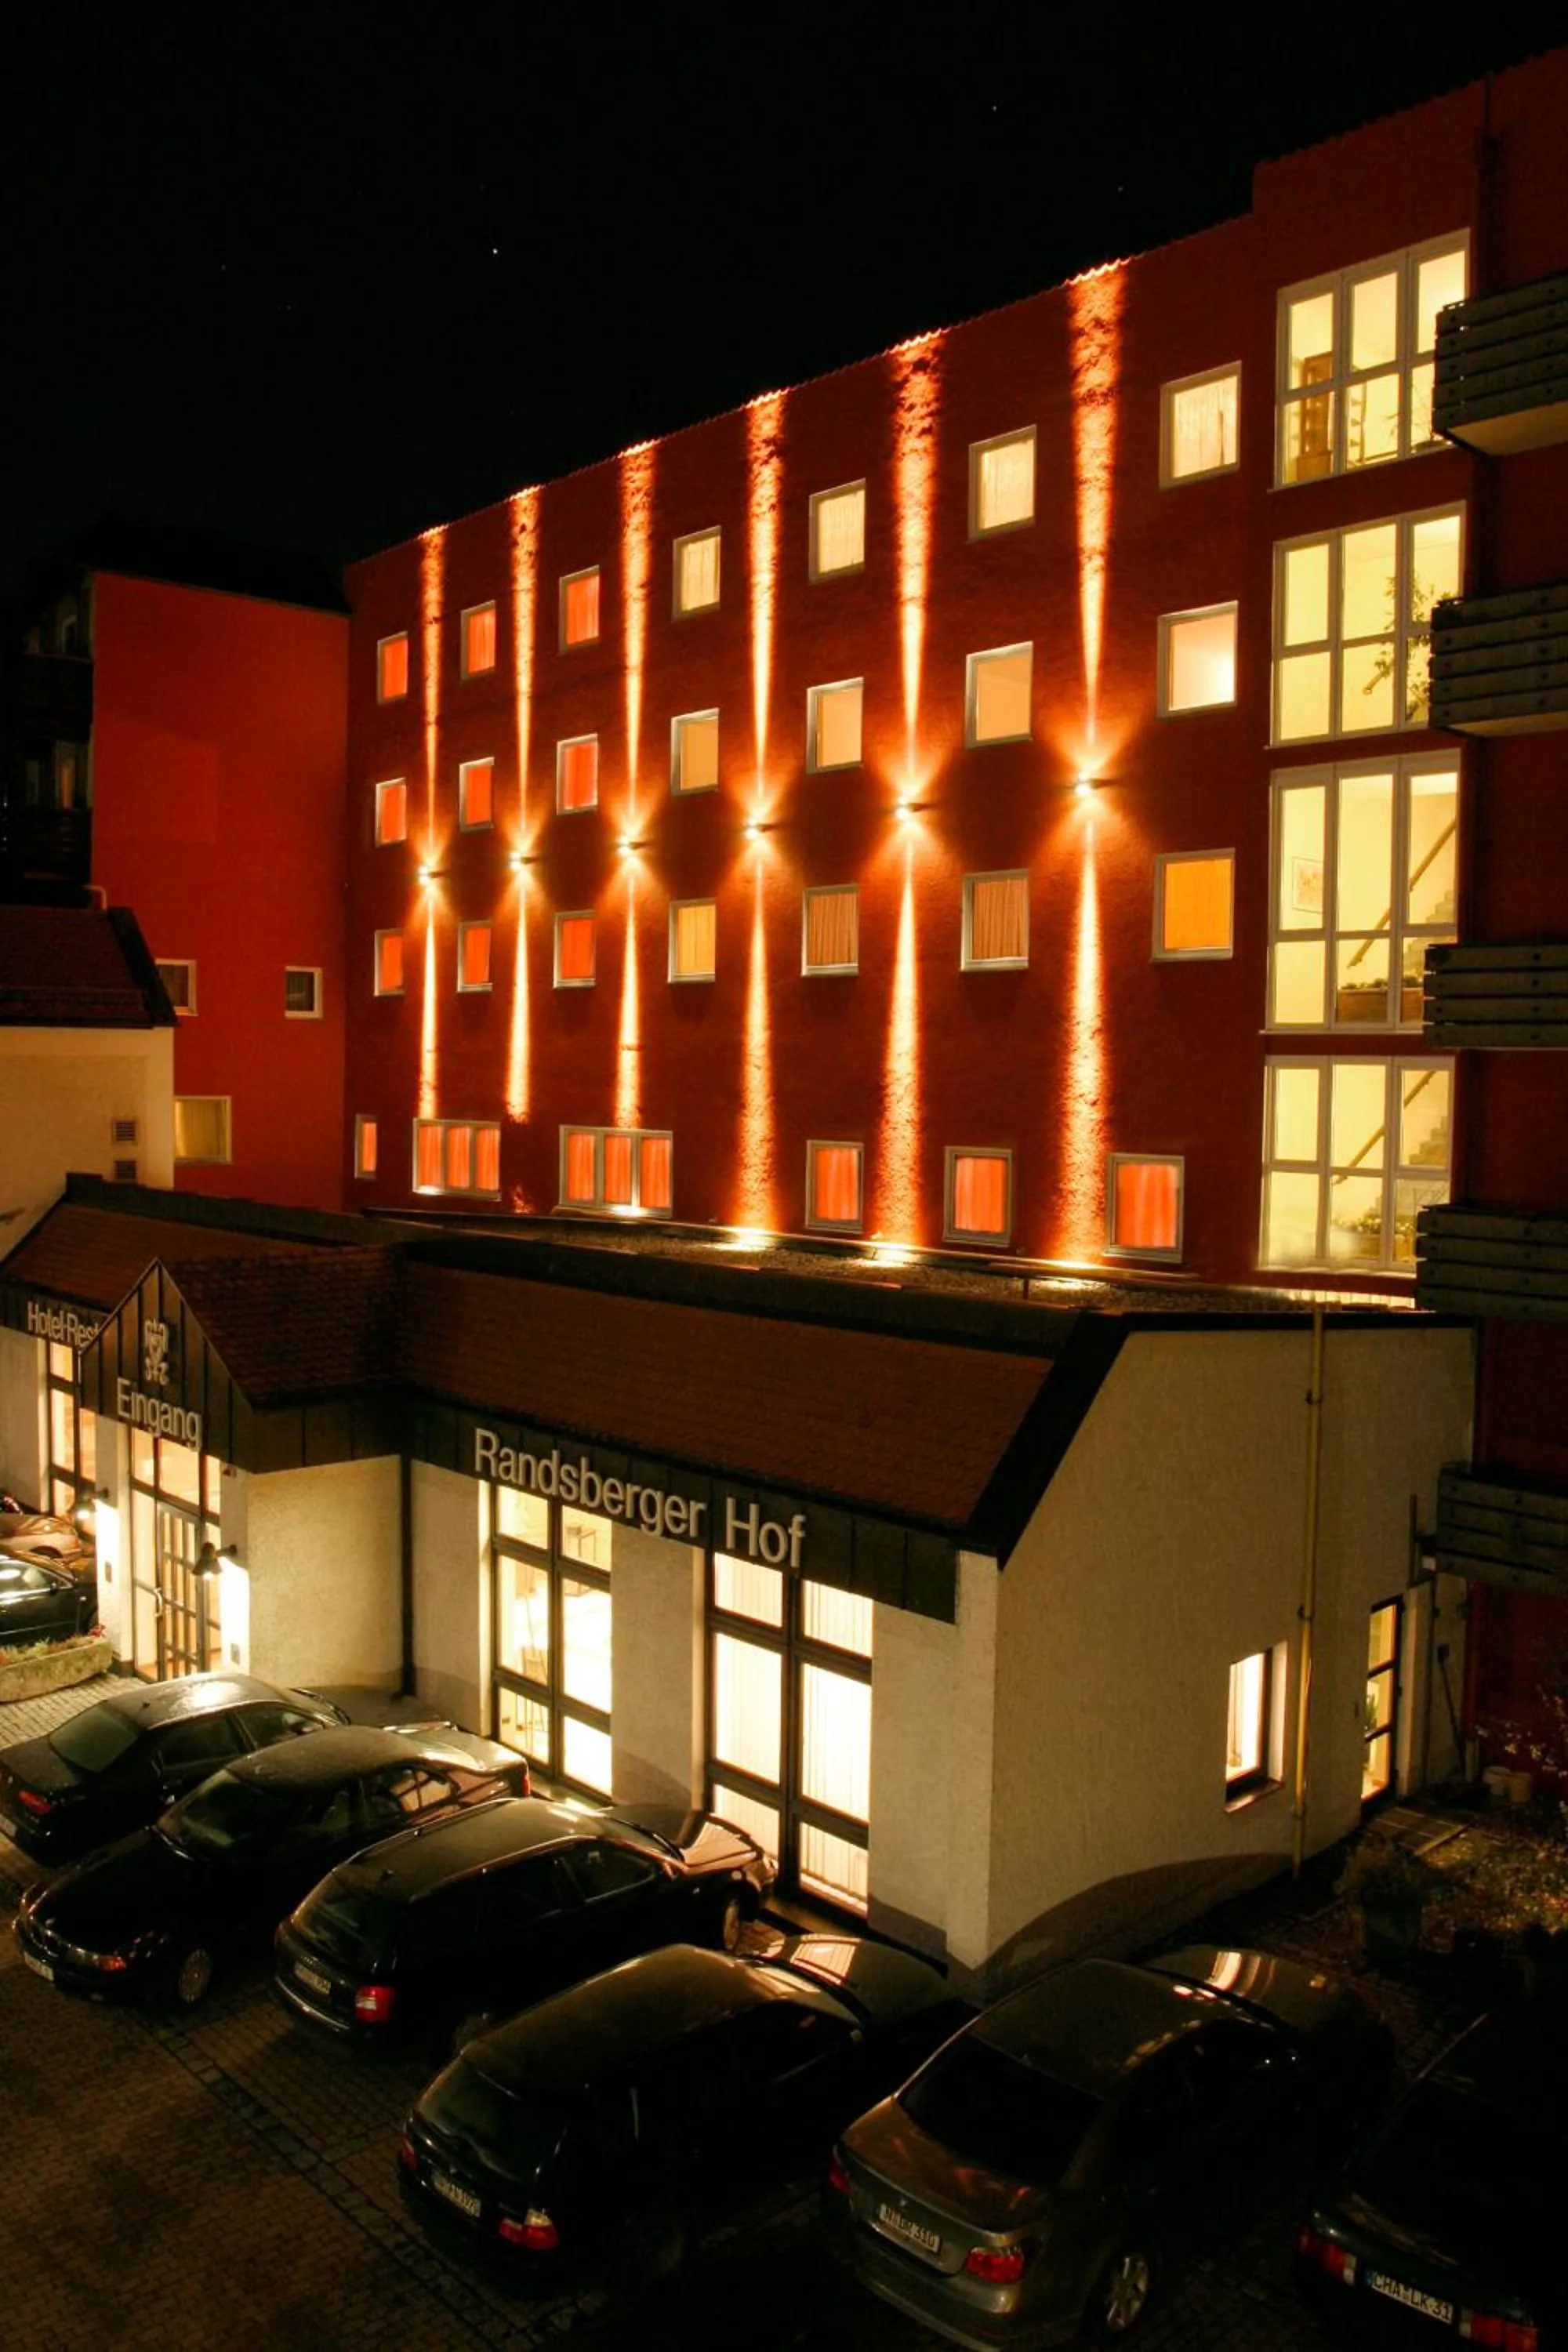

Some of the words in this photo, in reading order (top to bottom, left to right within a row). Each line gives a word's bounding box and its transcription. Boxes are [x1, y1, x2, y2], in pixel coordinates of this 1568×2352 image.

[118, 1377, 202, 1452] Eingang
[475, 1428, 706, 1537] Randsberger
[726, 1497, 806, 1568] Hof
